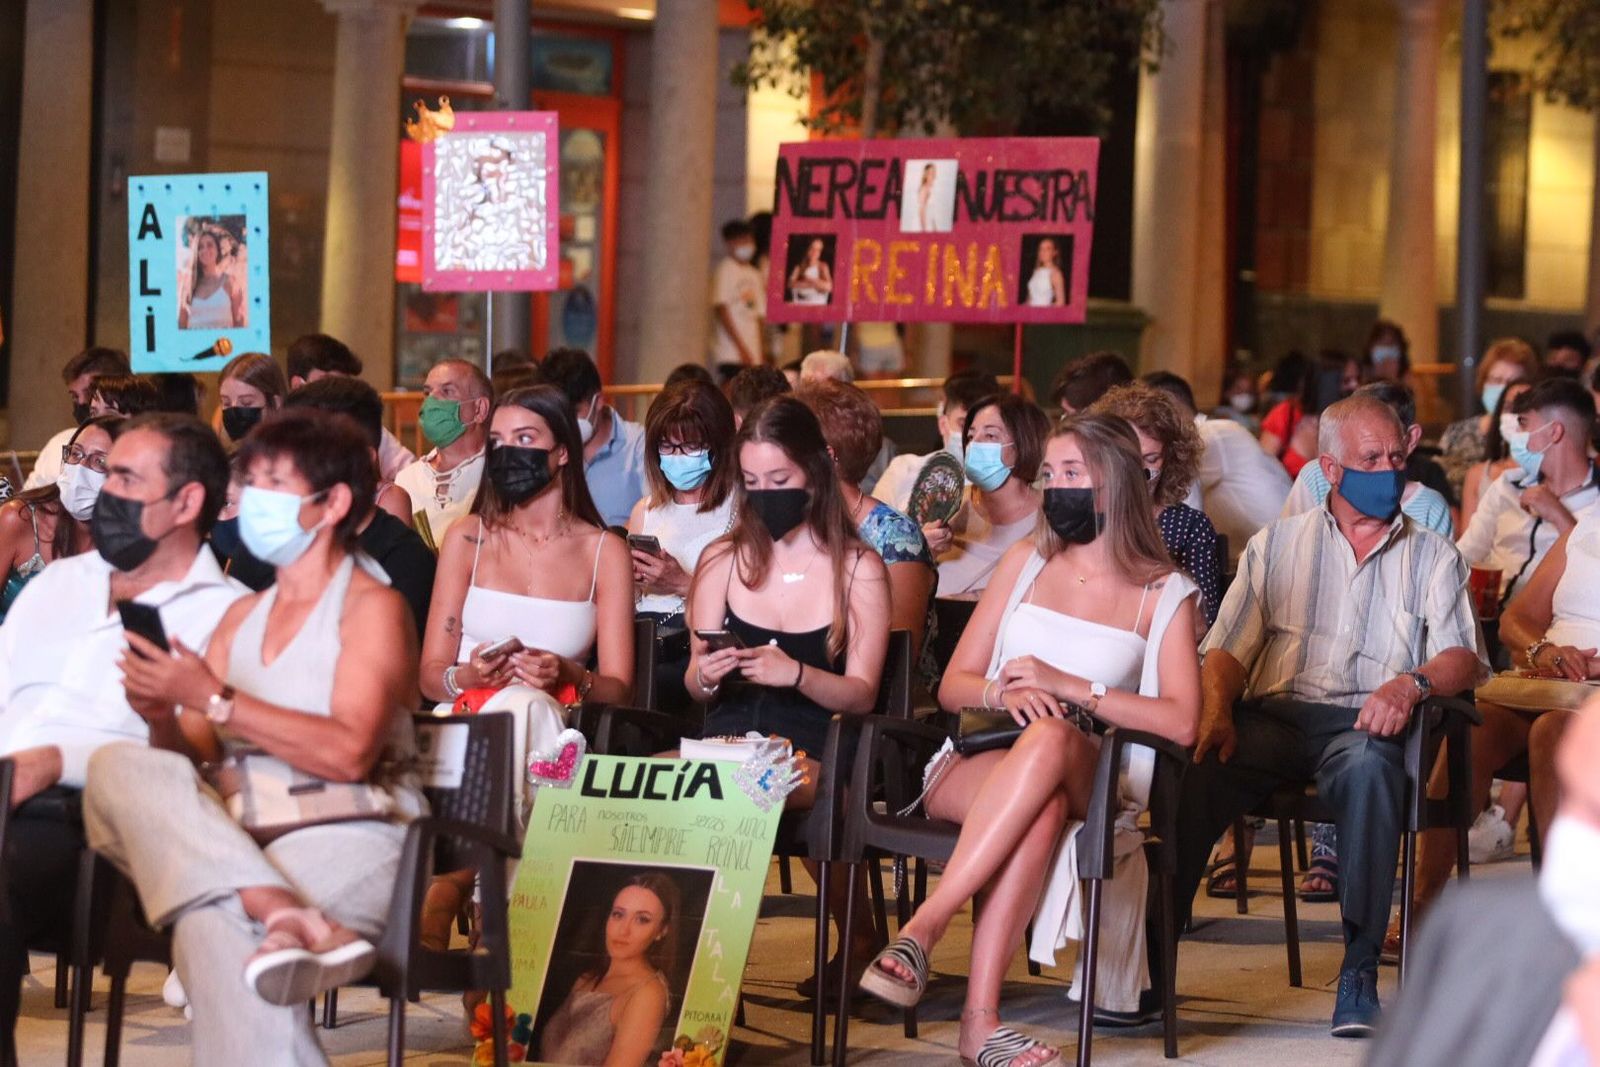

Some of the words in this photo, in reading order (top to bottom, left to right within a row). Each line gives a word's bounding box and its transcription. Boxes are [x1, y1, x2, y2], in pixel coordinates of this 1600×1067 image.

[773, 156, 902, 219] NEREA
[952, 169, 1095, 222] NUESTRA
[850, 237, 1008, 308] REINA
[548, 802, 587, 833] PARA
